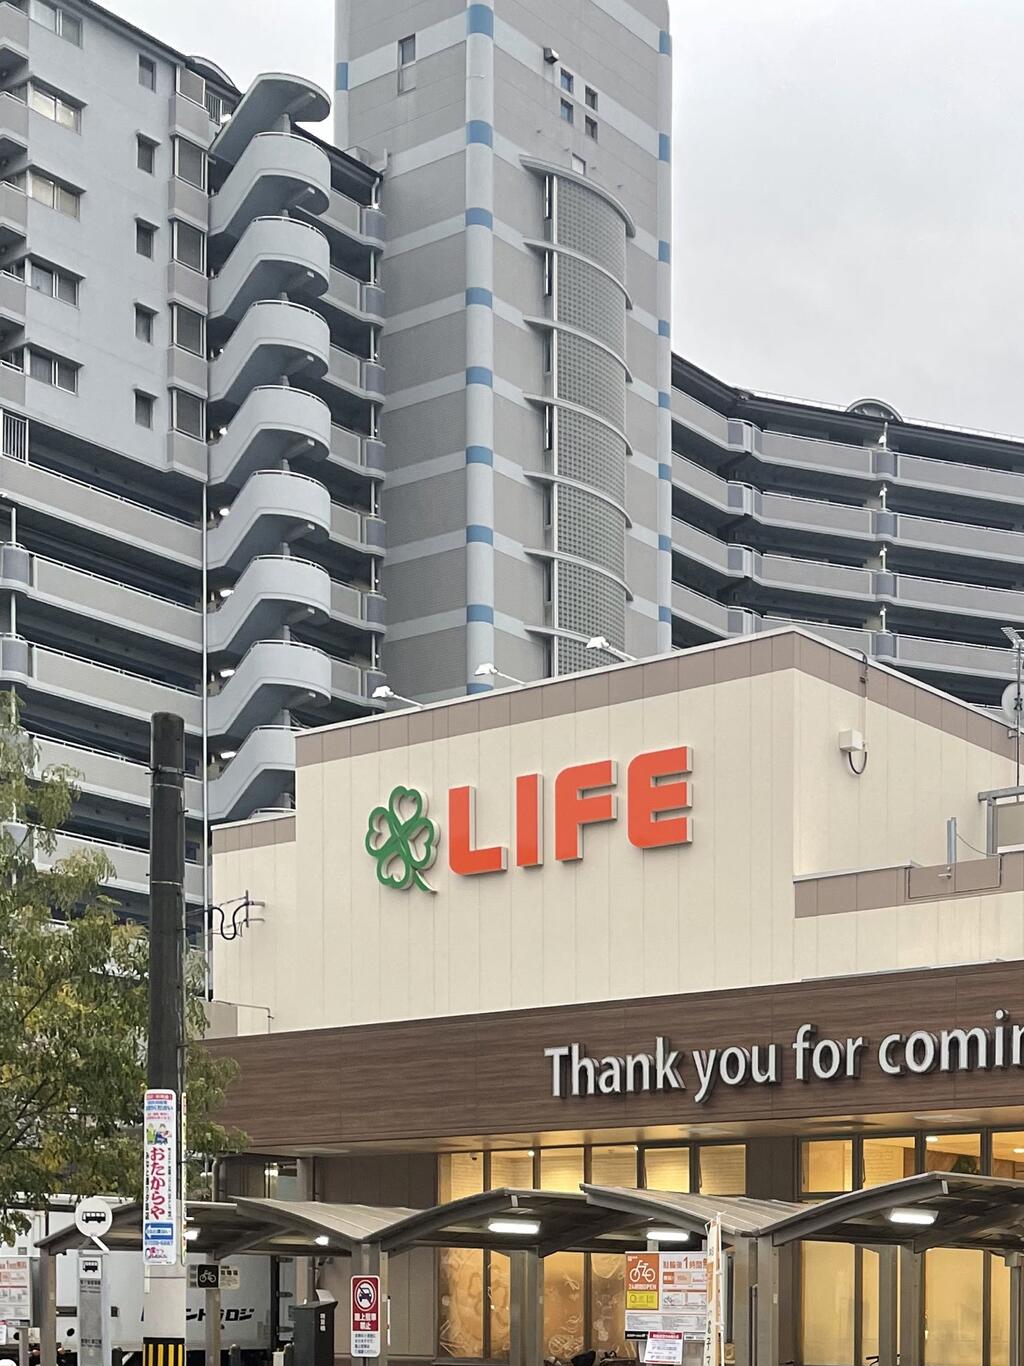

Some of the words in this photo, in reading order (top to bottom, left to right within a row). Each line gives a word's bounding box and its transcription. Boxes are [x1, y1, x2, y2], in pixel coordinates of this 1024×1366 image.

[448, 746, 693, 875] LIFE
[544, 1036, 686, 1098] Thank
[692, 1043, 780, 1102] you
[793, 1024, 867, 1081] for
[150, 1147, 166, 1220] おたからや
